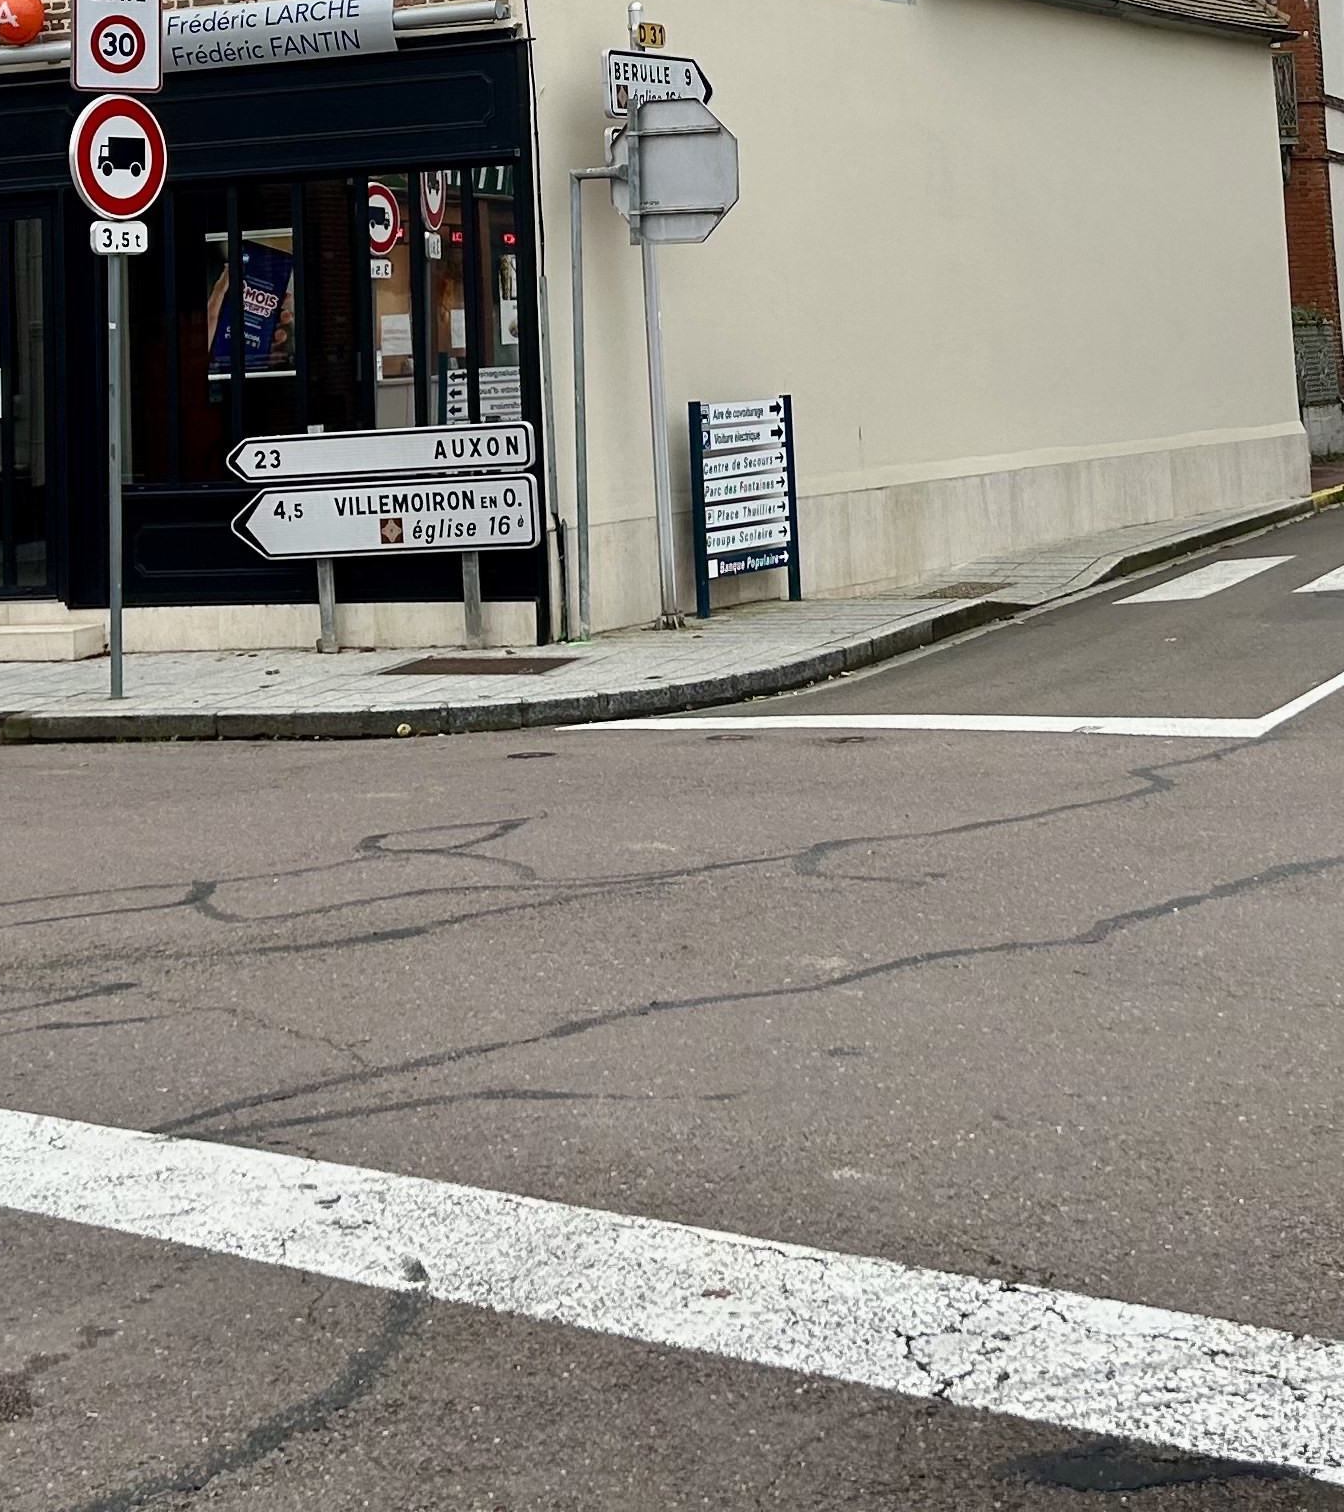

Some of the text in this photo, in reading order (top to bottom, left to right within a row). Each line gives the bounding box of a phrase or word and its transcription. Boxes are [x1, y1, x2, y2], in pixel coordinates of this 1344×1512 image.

[167, 8, 257, 36] Frédéric
[102, 32, 136, 57] 30
[171, 28, 361, 67] Frédéric FANTIN
[639, 25, 664, 46] D 31
[614, 62, 692, 86] BERULLE 9
[102, 227, 142, 251] 3,5 t
[712, 409, 724, 420] Aire
[725, 408, 732, 419] de
[254, 436, 520, 470] 23 AUXON
[703, 456, 773, 475] Centre de Secours
[704, 479, 775, 497] Parc des Fontaines
[273, 500, 304, 522] 4,5
[333, 489, 476, 517] VILLEMOIRON
[480, 496, 498, 510] EN
[717, 509, 739, 521] Place
[742, 503, 776, 518] Thuillier
[412, 519, 477, 545] église
[706, 528, 773, 548] Groupe Scolaire
[719, 553, 779, 575] Banque Populaire
